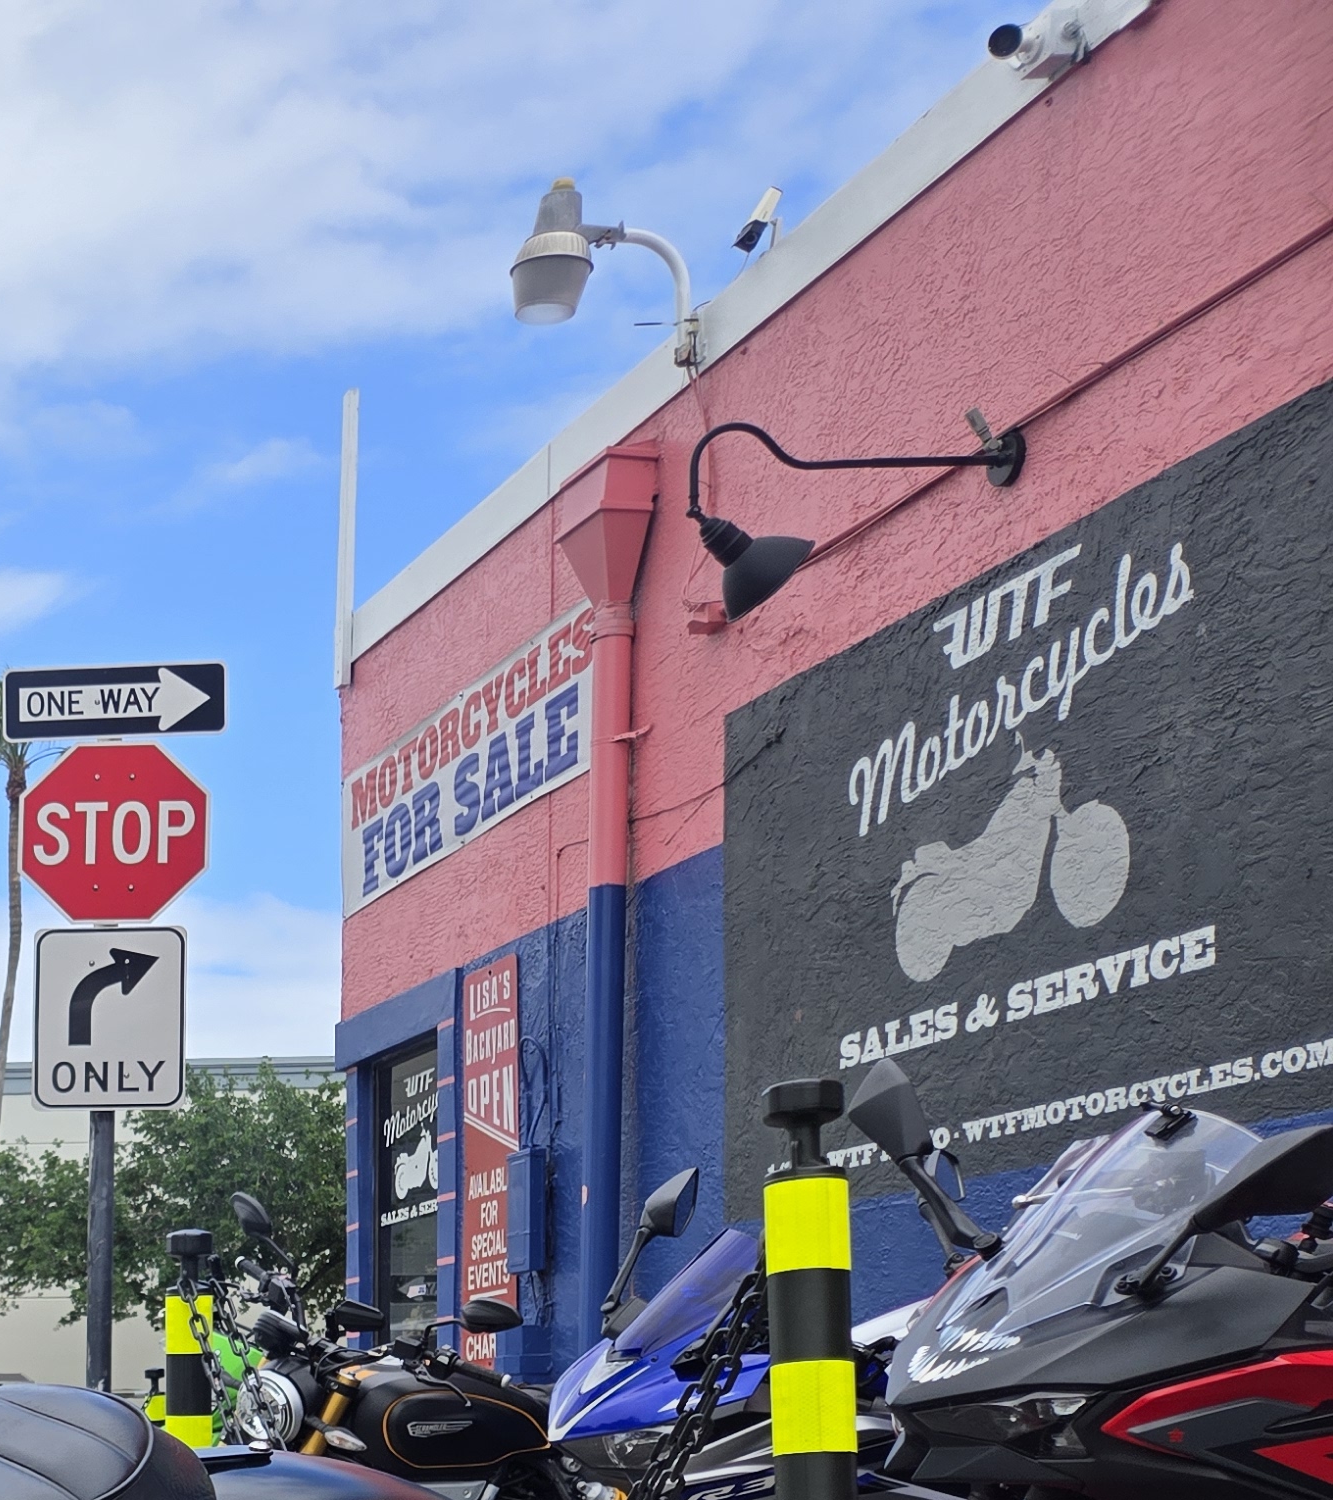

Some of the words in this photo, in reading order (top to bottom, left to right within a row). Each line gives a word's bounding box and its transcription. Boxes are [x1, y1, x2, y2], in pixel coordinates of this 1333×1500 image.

[933, 543, 1081, 669] WTF
[26, 690, 84, 718] ONE
[101, 687, 161, 714] WAY
[849, 543, 1195, 837] Motorcycles
[351, 608, 593, 831] MOTORCYCLES
[362, 781, 443, 897] FOR
[454, 682, 579, 836] SALE
[33, 800, 196, 866] STOP
[469, 969, 511, 1022] LISA'S
[839, 1002, 958, 1069] SALES
[965, 993, 1000, 1033] &
[1006, 925, 1216, 1022] SERVICE
[52, 1060, 166, 1093] ONLY
[403, 1067, 435, 1098] WTF
[467, 1064, 515, 1135] OPEN
[962, 1037, 1333, 1143] WTFMOTORCYCLES.COM
[383, 1090, 439, 1148] Motorcy
[468, 1166, 507, 1201] AVAILABL
[480, 1200, 498, 1228] FOR
[471, 1229, 507, 1261] SPECIAL
[467, 1258, 511, 1291] EVENTS
[465, 1332, 496, 1362] CHAR
